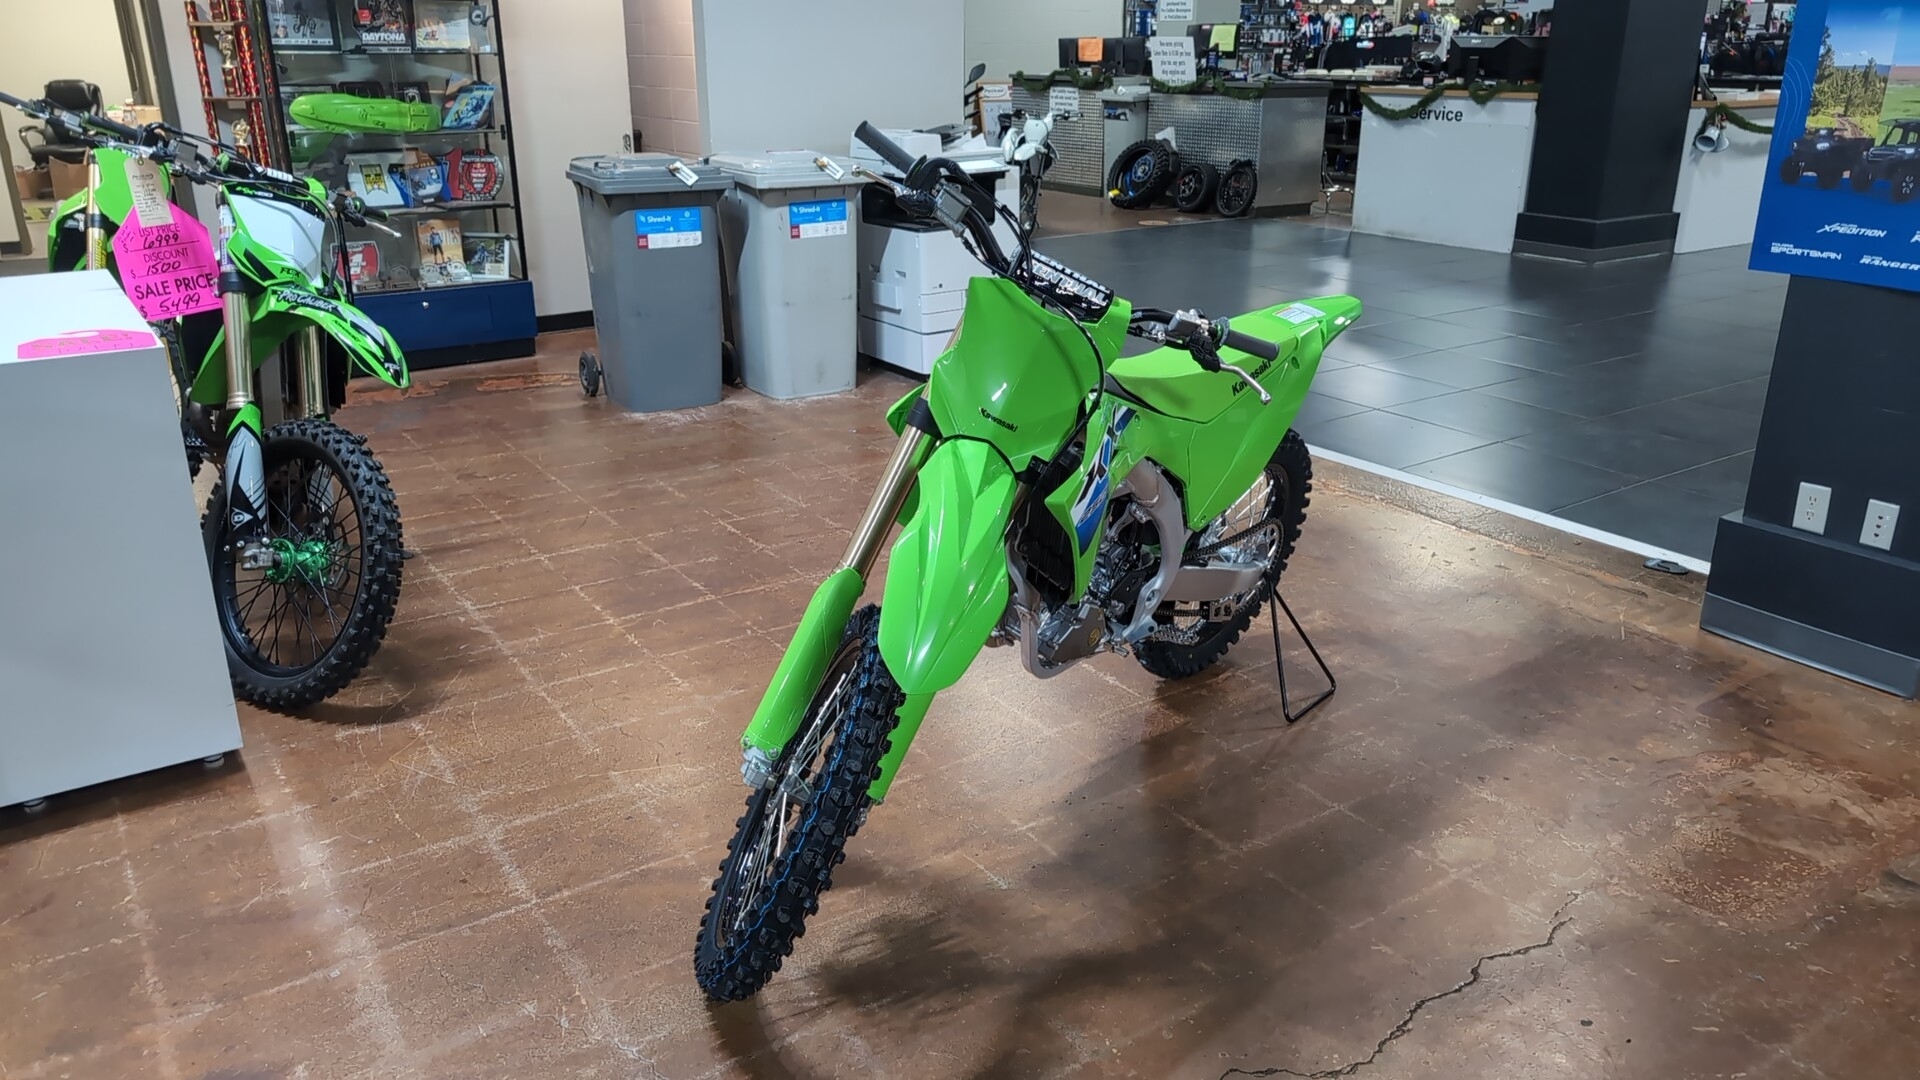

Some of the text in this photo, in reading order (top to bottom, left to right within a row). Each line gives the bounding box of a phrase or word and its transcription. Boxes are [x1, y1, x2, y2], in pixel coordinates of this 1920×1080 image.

[362, 33, 406, 41] DAYTONA
[646, 215, 672, 224] Shred-it
[156, 223, 181, 235] PRICE
[1816, 223, 1887, 238] XPEDITION
[143, 247, 190, 263] DISCOUNT
[1770, 247, 1842, 260] SPORTSMAN
[134, 272, 215, 300] SALE PRICE
[980, 407, 1019, 432] Kawasaki
